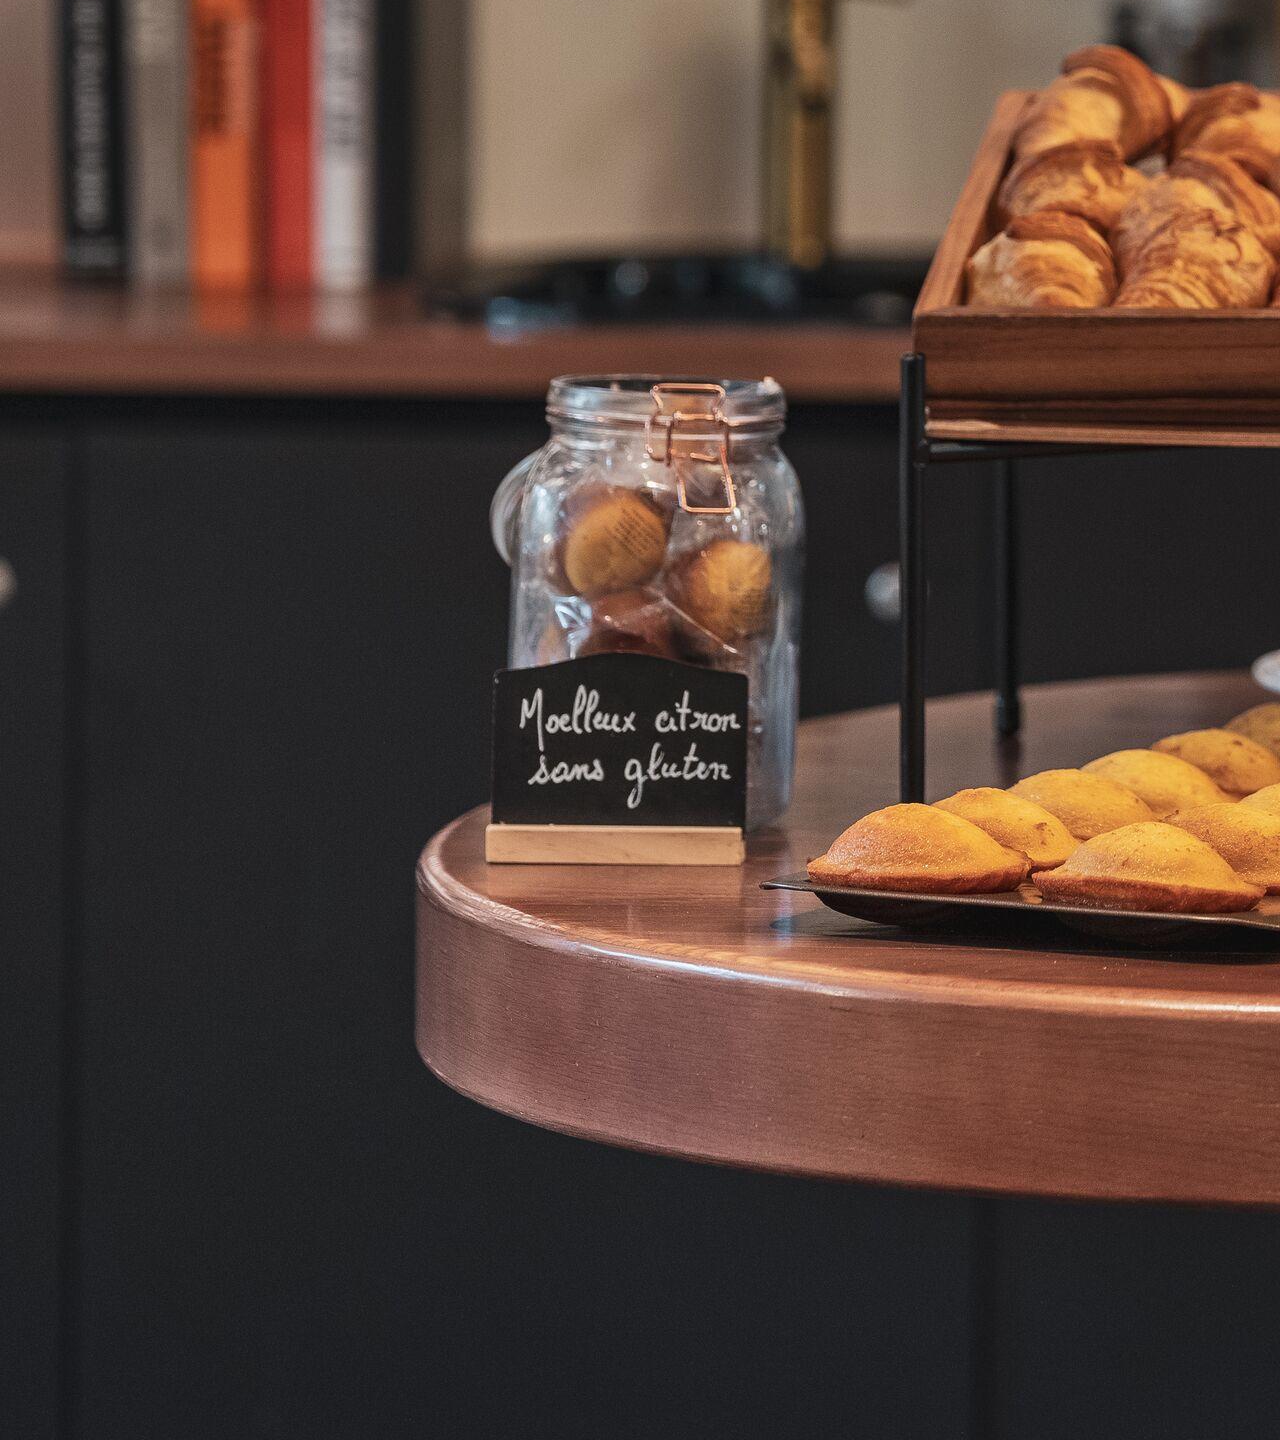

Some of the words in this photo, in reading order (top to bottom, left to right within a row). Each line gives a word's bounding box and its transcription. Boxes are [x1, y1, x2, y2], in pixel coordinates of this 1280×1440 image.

[519, 685, 636, 752] Moelleux
[655, 690, 741, 733] citron
[528, 755, 605, 785] sans
[624, 742, 731, 809] gluten
